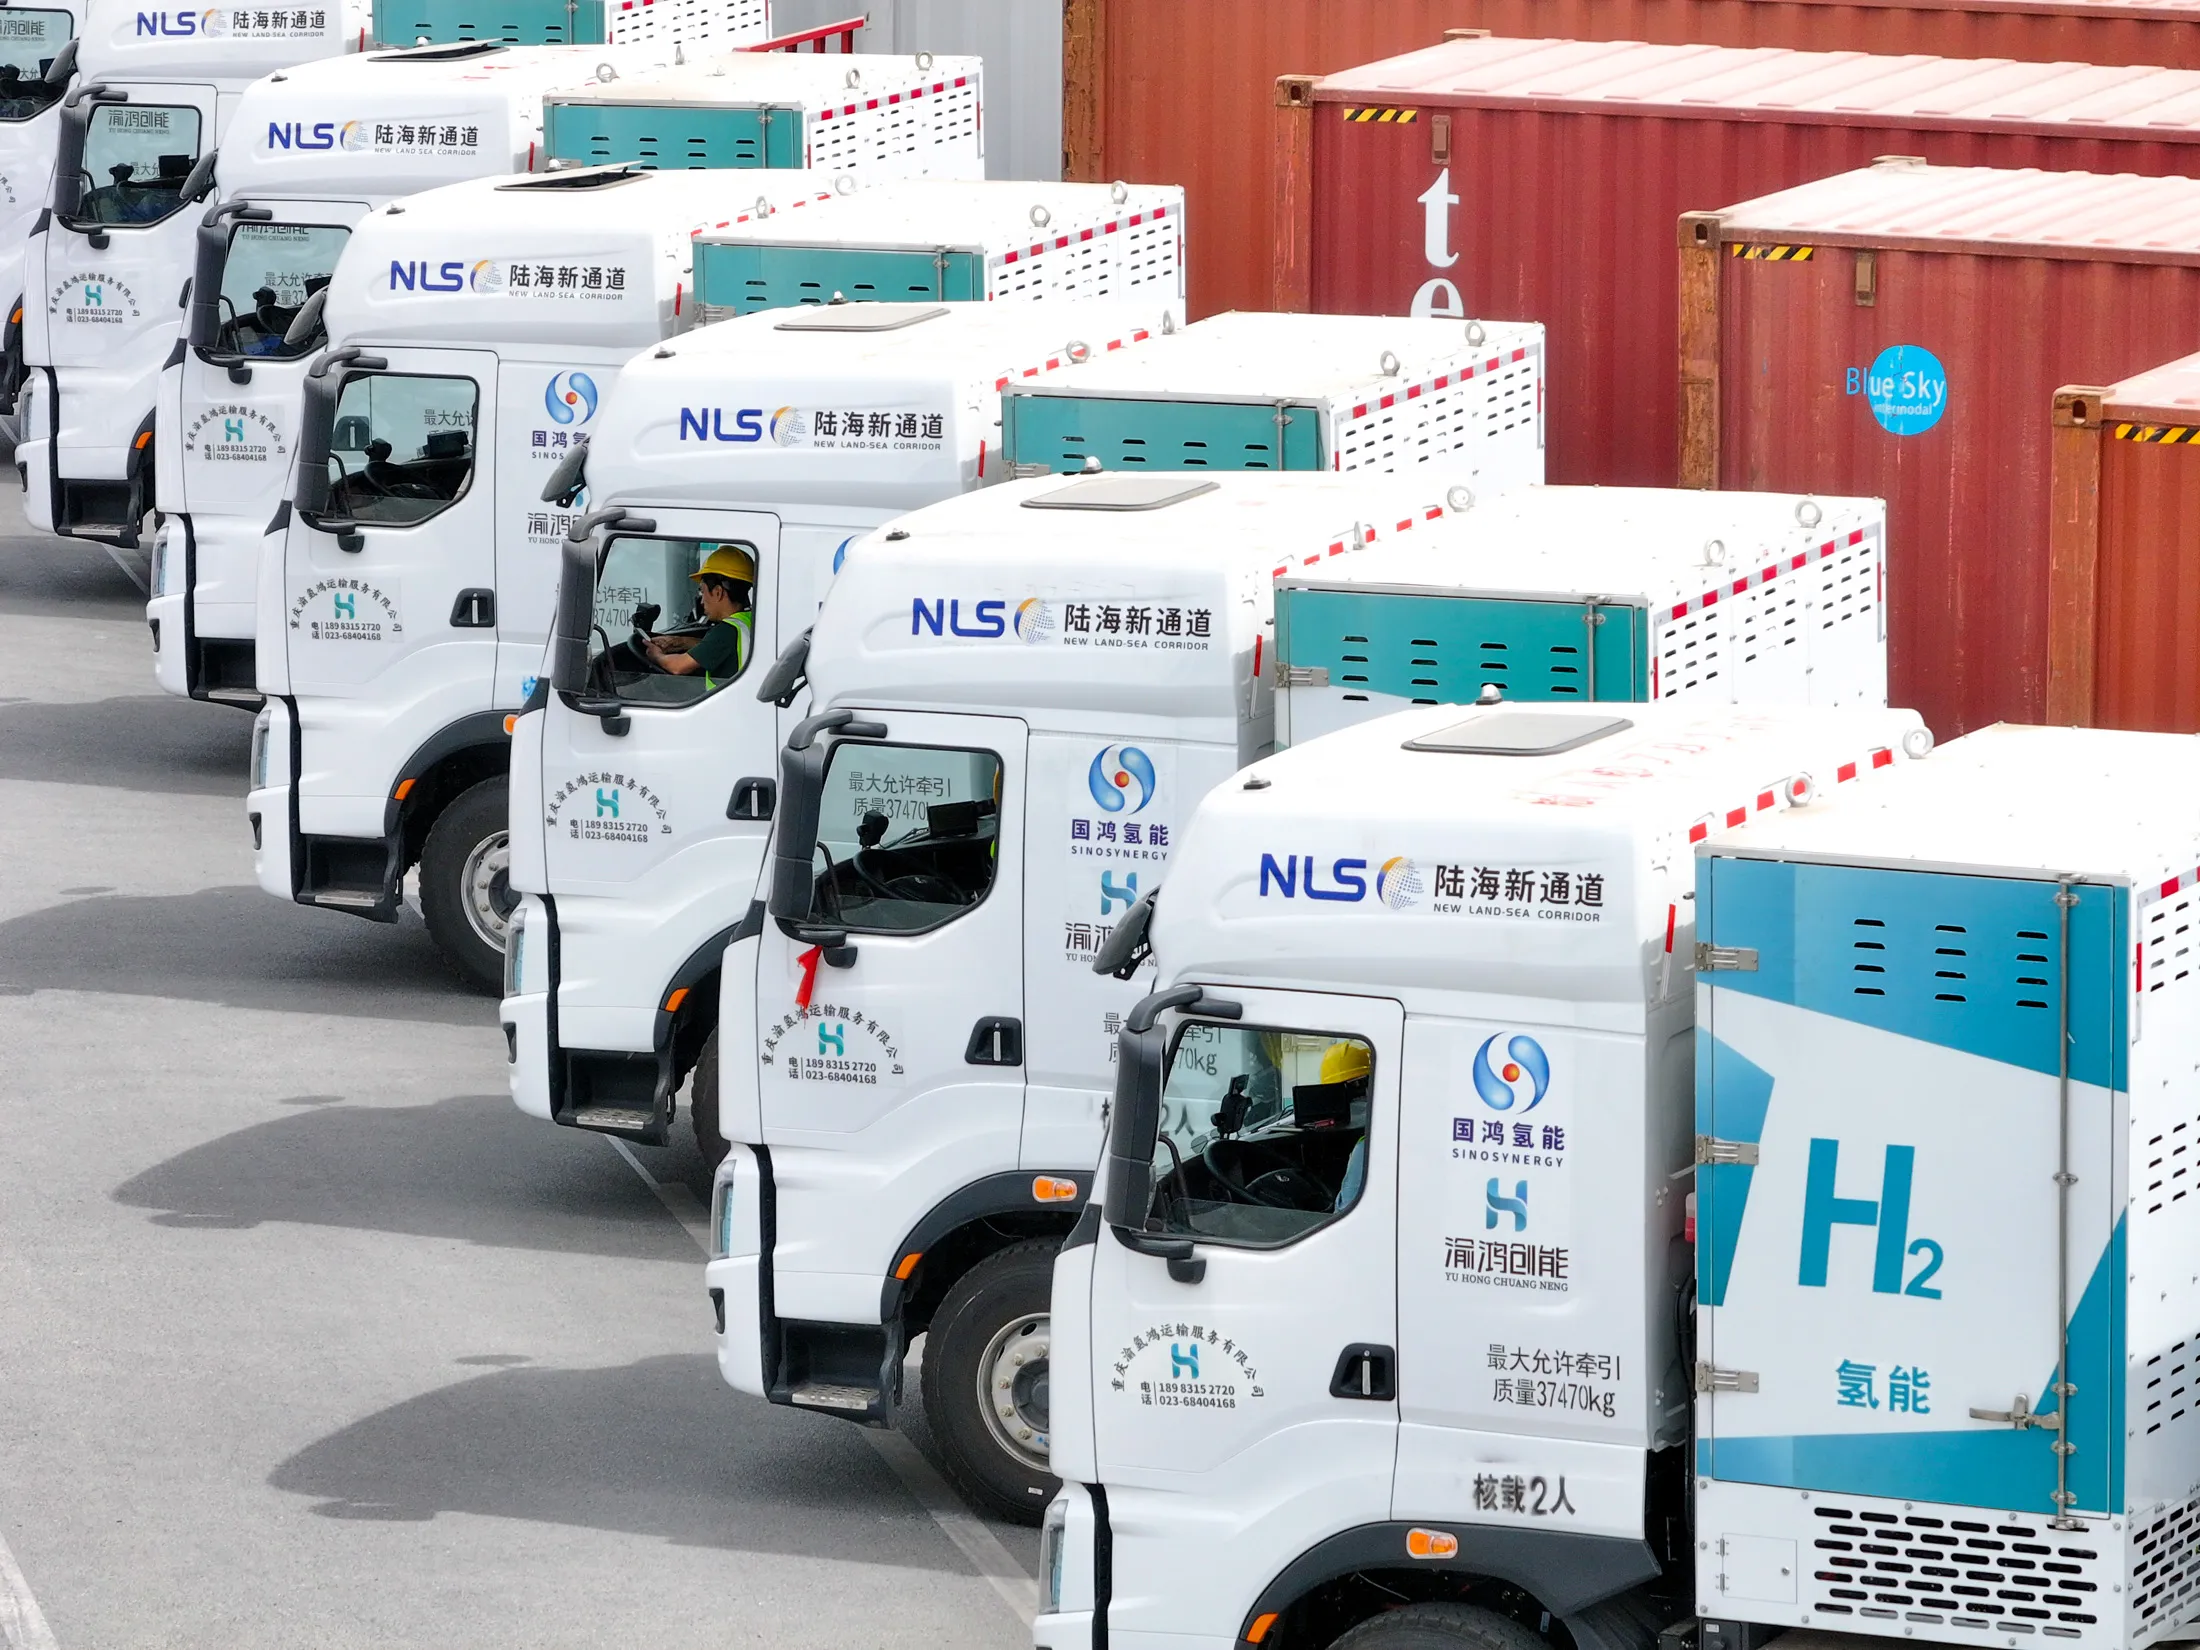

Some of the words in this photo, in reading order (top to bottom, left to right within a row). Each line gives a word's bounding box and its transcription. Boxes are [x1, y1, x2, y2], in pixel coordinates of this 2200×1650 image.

[136, 12, 196, 36] NLS
[233, 10, 326, 29] 陆海新通道
[268, 122, 334, 149] NLS
[375, 124, 478, 147] 陆海新通道
[390, 260, 464, 292] NLS
[510, 264, 625, 290] 陆海新通道
[580, 292, 623, 300] CORRIDOR
[1846, 367, 1894, 398] Blue
[1902, 370, 1945, 407] Sky
[680, 407, 762, 442] NLS
[814, 410, 943, 439] 陆海新通道
[217, 444, 229, 452] 189
[814, 440, 835, 448] NEW
[840, 441, 888, 449] LAND-SEA
[894, 442, 941, 450] CORRIDOR
[217, 453, 267, 461] 023-68404168
[325, 622, 339, 630] 189
[341, 622, 359, 630] 8315
[361, 623, 380, 631] 2720
[912, 598, 1005, 638] NLS
[1064, 604, 1212, 638] 陆海新通道
[325, 632, 381, 641] 023-68404168
[1064, 638, 1088, 646] NEW
[1094, 639, 1148, 648] LAND-SEA
[1154, 641, 1208, 650] CORRIDOR
[849, 772, 950, 797] 最大允许牵引
[585, 820, 601, 829] 189
[603, 821, 624, 830] 8315
[626, 822, 648, 832] 2720
[585, 831, 648, 843] 023-68404168
[1072, 818, 1169, 846] 国鸿氢能
[1072, 845, 1168, 861] SINOSYNERGY
[1260, 853, 1367, 902] NLS
[1434, 864, 1605, 908] 陆海新通道
[1434, 904, 1462, 913] NEW
[1469, 906, 1530, 918] LAND-SEA
[1538, 910, 1600, 922] CORRIDOR
[806, 1059, 824, 1068] 189
[826, 1060, 850, 1070] 8315
[852, 1061, 876, 1072] 2720
[806, 1070, 877, 1084] 023-68404168
[1453, 1117, 1564, 1151] 国鸿氢能
[1452, 1148, 1564, 1168] SINOSYNERGY
[1445, 1236, 1568, 1279] 渝鸿创能
[1445, 1272, 1458, 1282] YU
[1462, 1274, 1490, 1285] HONG
[1494, 1277, 1537, 1289] CHUANG
[1540, 1280, 1568, 1292] NENG
[1487, 1344, 1620, 1381] 最大允许牵引
[1140, 1382, 1151, 1405] 电话
[1160, 1383, 1178, 1393] 189
[1180, 1384, 1206, 1394] 8315
[1209, 1385, 1235, 1395] 2720
[1493, 1378, 1616, 1418] 质量37470kg
[1836, 1359, 1931, 1415] 氢能
[1160, 1395, 1236, 1409] 023-68404168
[1473, 1472, 1576, 1516] 核载2人
